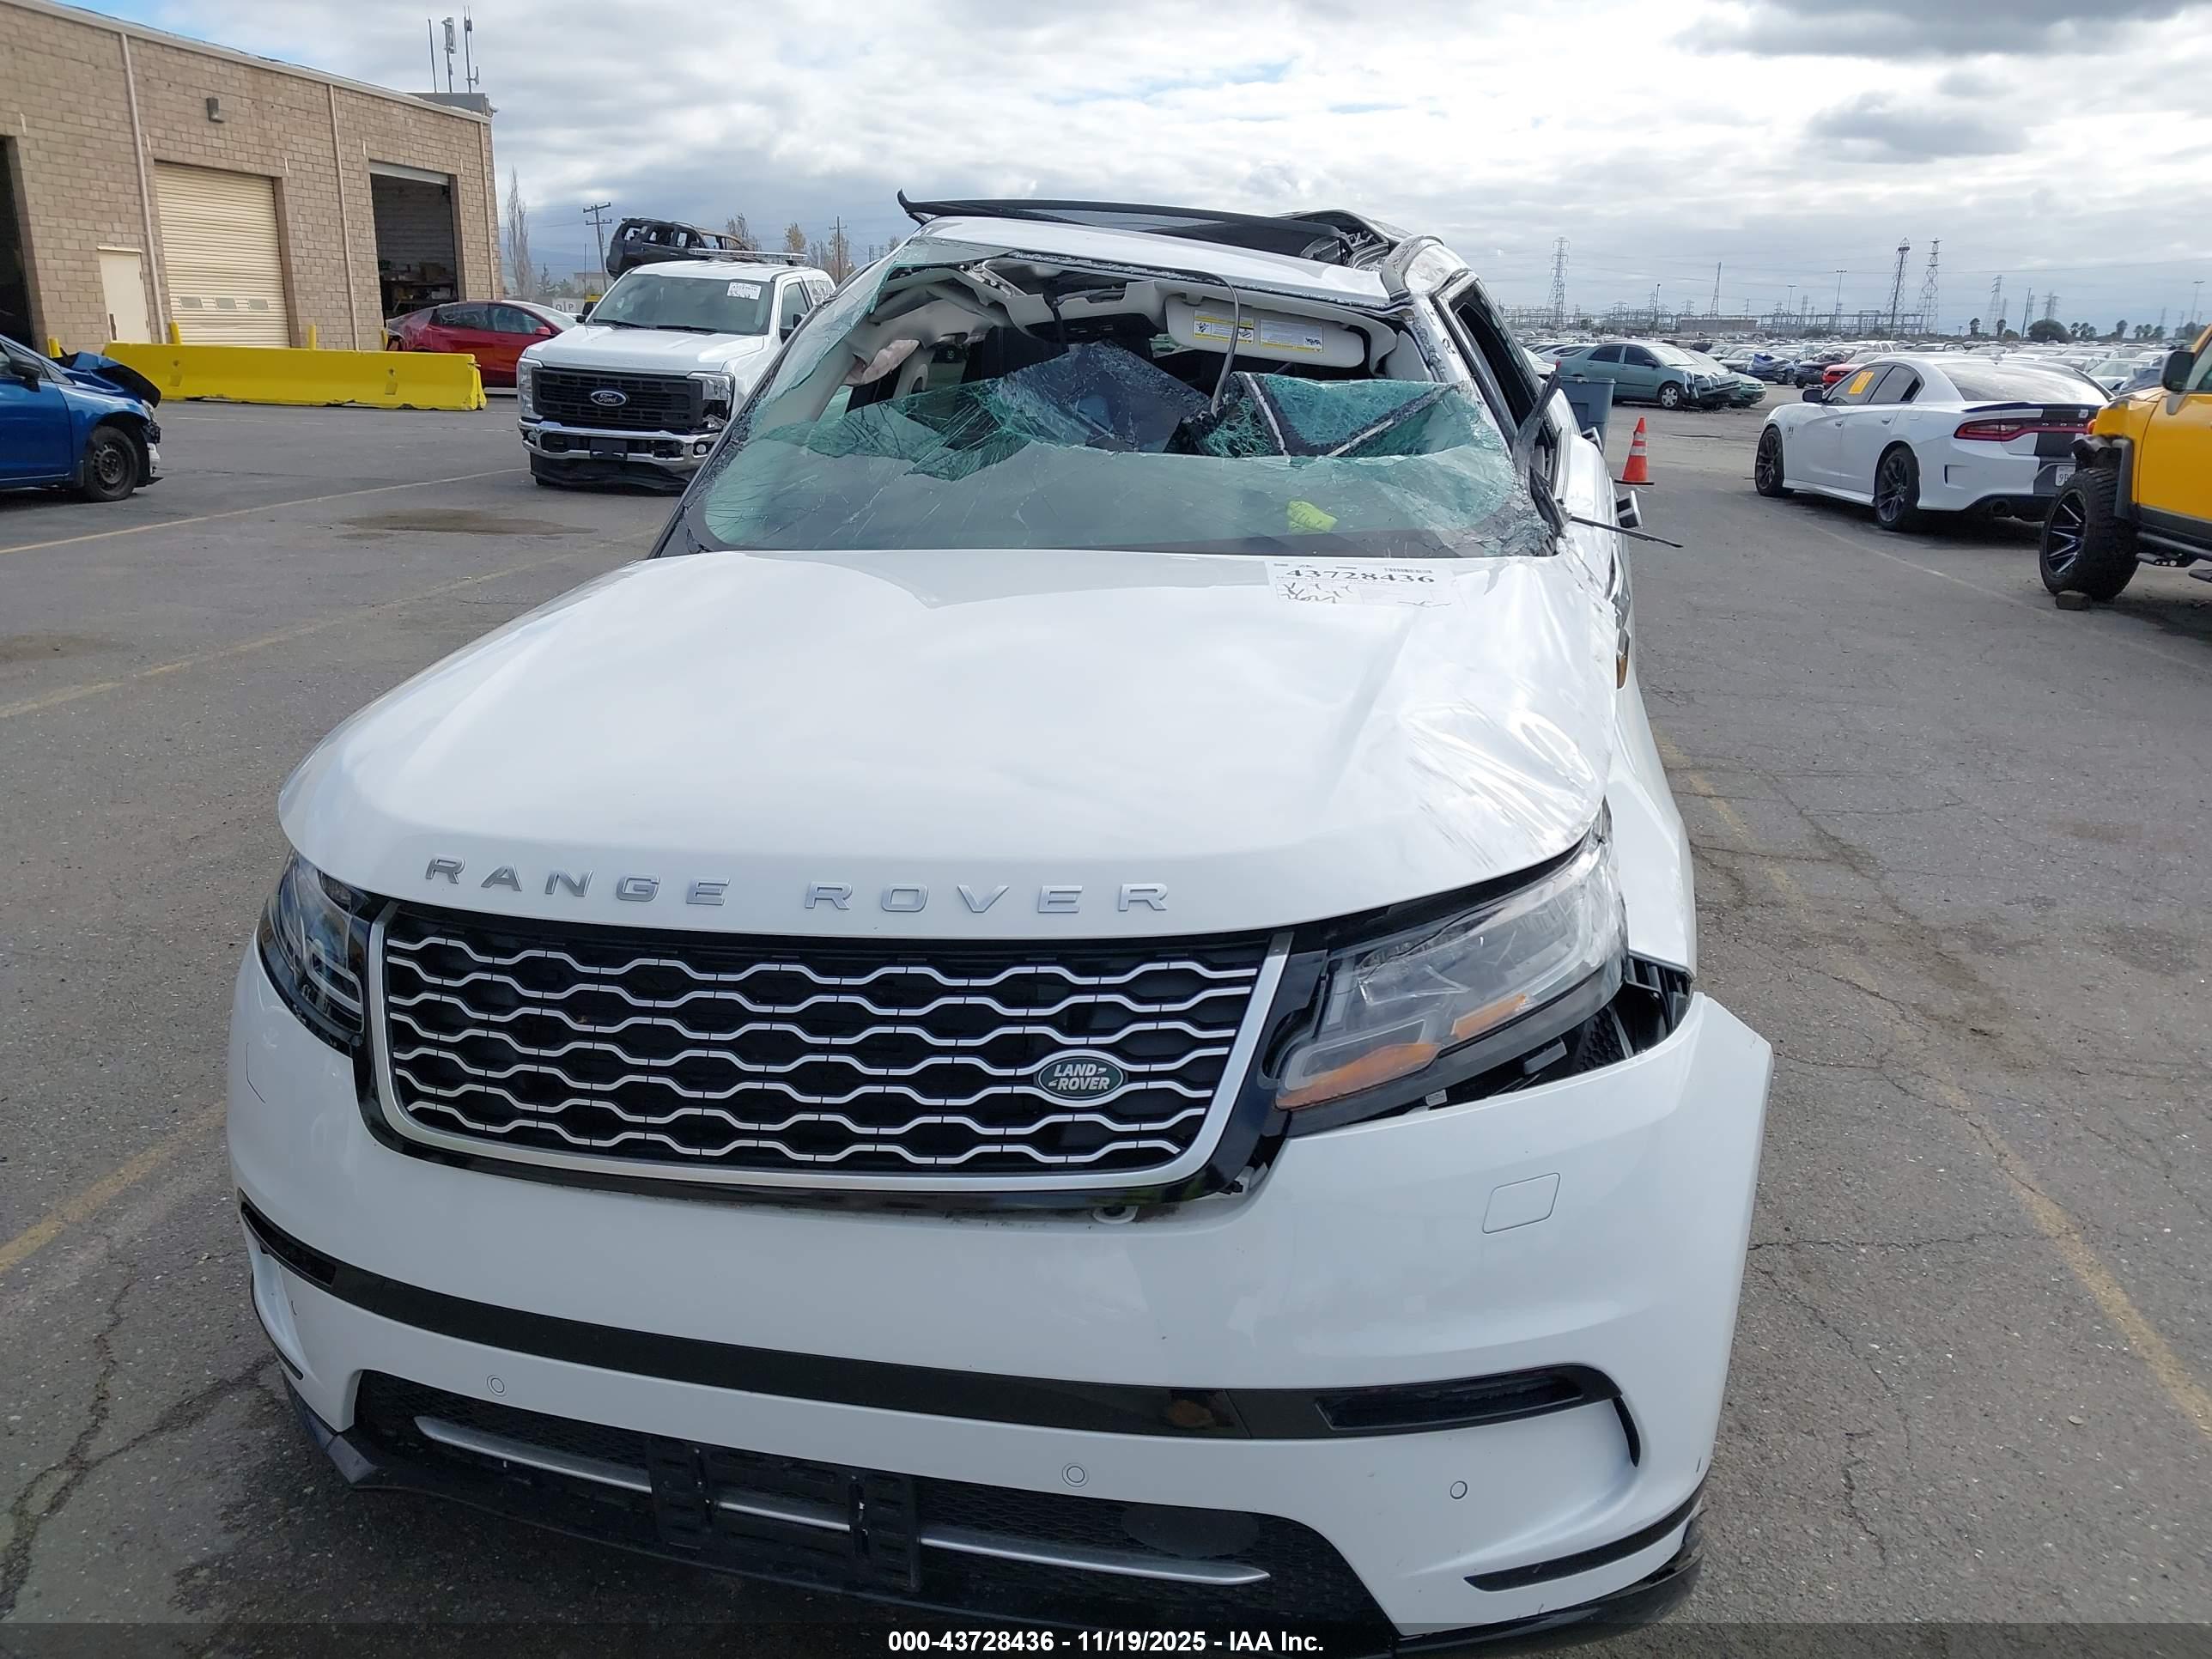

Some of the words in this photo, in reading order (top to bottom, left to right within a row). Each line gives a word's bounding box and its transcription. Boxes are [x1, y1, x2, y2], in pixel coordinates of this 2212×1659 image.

[598, 392, 618, 404] Ford
[1285, 568, 1435, 583] 43728436
[426, 855, 731, 907] RANGE
[805, 881, 1170, 915] ROVER
[1057, 1077, 1110, 1091] ROVER
